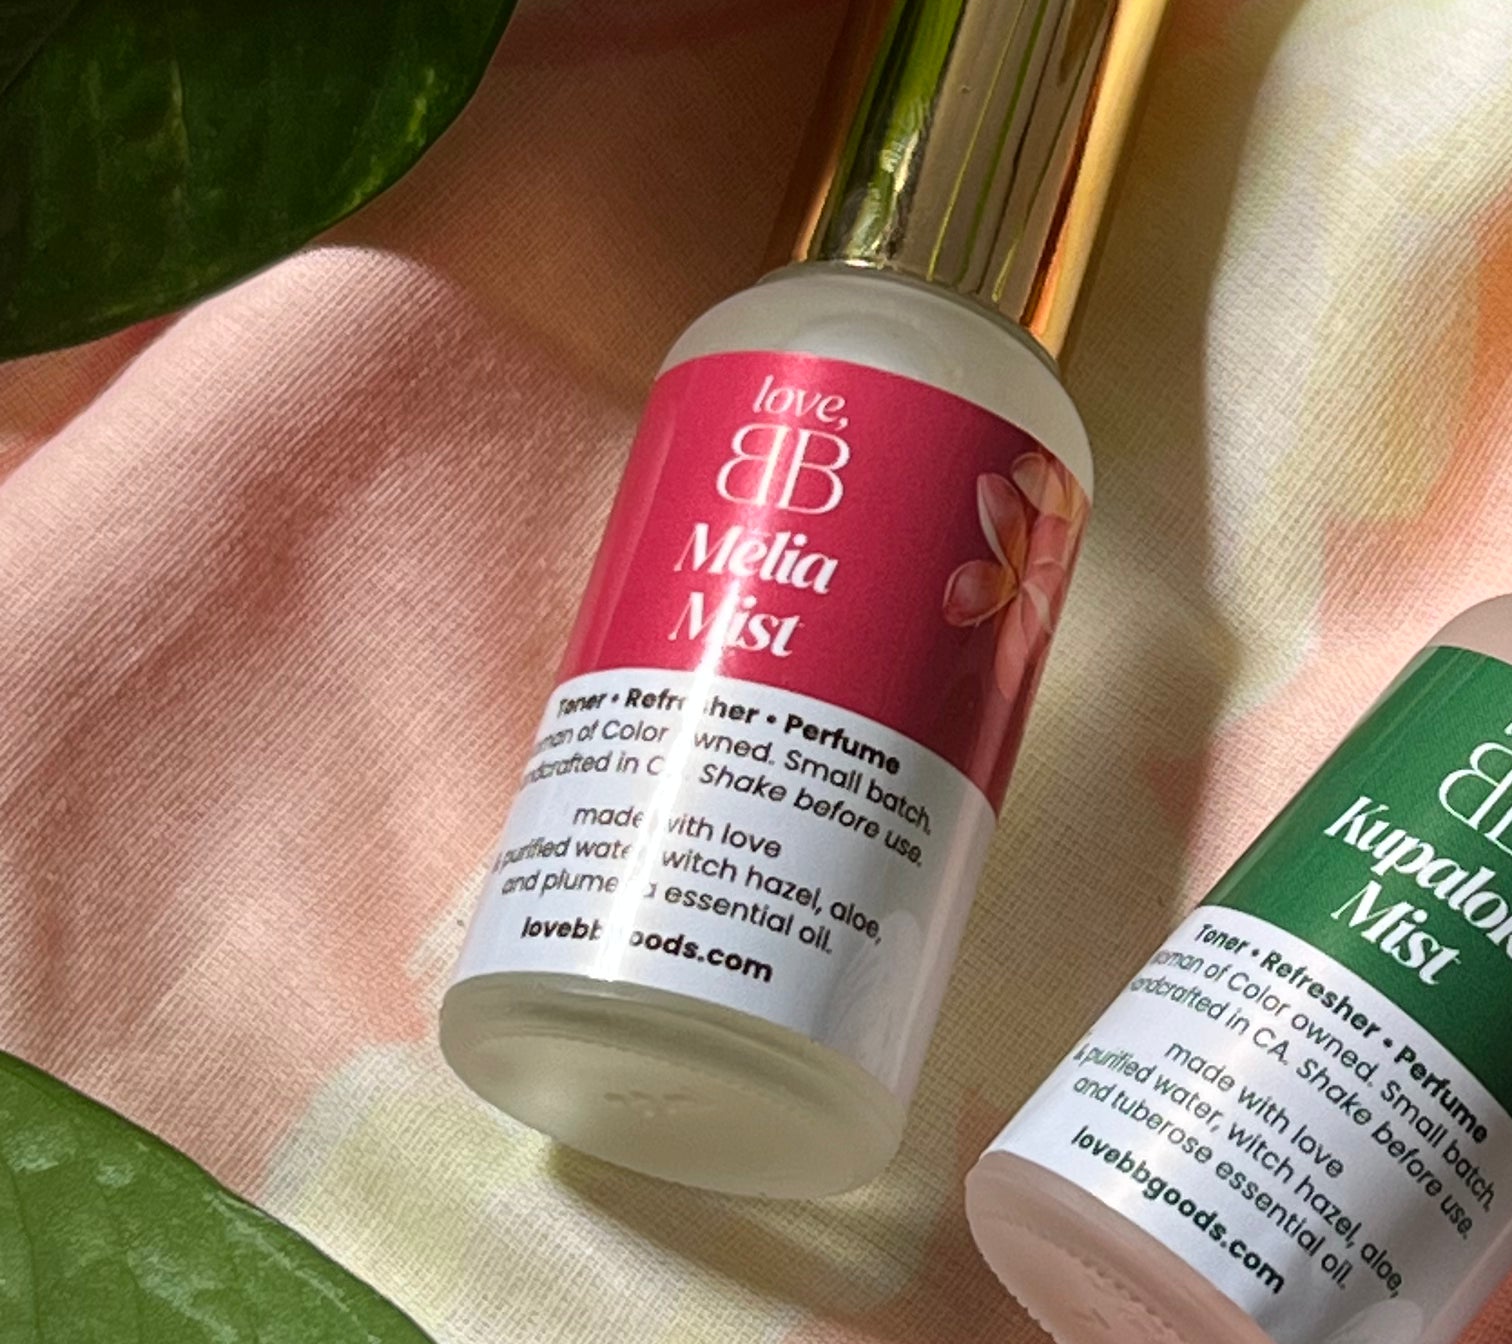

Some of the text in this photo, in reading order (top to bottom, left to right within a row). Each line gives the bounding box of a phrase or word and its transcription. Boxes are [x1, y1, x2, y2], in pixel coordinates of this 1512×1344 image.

[752, 374, 849, 432] love,
[668, 591, 804, 657] Mist
[557, 687, 900, 776] Toner Refrher Perfume
[577, 719, 599, 738] of
[601, 719, 669, 743] Color
[694, 731, 775, 765] wned.
[785, 749, 863, 794] Small
[616, 752, 640, 775] in
[699, 763, 787, 802] Shake
[793, 788, 880, 838] before
[884, 829, 922, 867] use.
[720, 823, 782, 858] love
[500, 835, 572, 871] purified
[662, 848, 738, 883] witch
[744, 865, 822, 916] hazel,
[830, 901, 882, 946] aloe,
[501, 870, 541, 896] and
[665, 885, 795, 937] essential
[798, 925, 833, 955] oil.
[1330, 880, 1461, 985] Mist
[520, 916, 773, 983] lovebboods.com
[1194, 923, 1488, 1144] Toner Refresher Perfume
[1204, 963, 1233, 982] of
[1227, 972, 1291, 1018] Color
[1291, 1013, 1379, 1088] owned.
[1381, 1080, 1448, 1148] Small
[1164, 1043, 1344, 1179] made with love
[1225, 1007, 1251, 1036] in
[1253, 1027, 1289, 1066] CA.
[1296, 1058, 1372, 1125] Shake
[1372, 1121, 1442, 1197] before
[1441, 1194, 1473, 1239] use.
[1070, 1125, 1285, 1295] lovebbgoods.com
[1072, 1076, 1353, 1290] and tuberose essential oil.
[1079, 1046, 1158, 1083] purified
[1153, 1074, 1223, 1133] water,
[1227, 1122, 1294, 1184] witch
[1294, 1174, 1362, 1249] hazel,
[1360, 1242, 1402, 1298] aloe,
